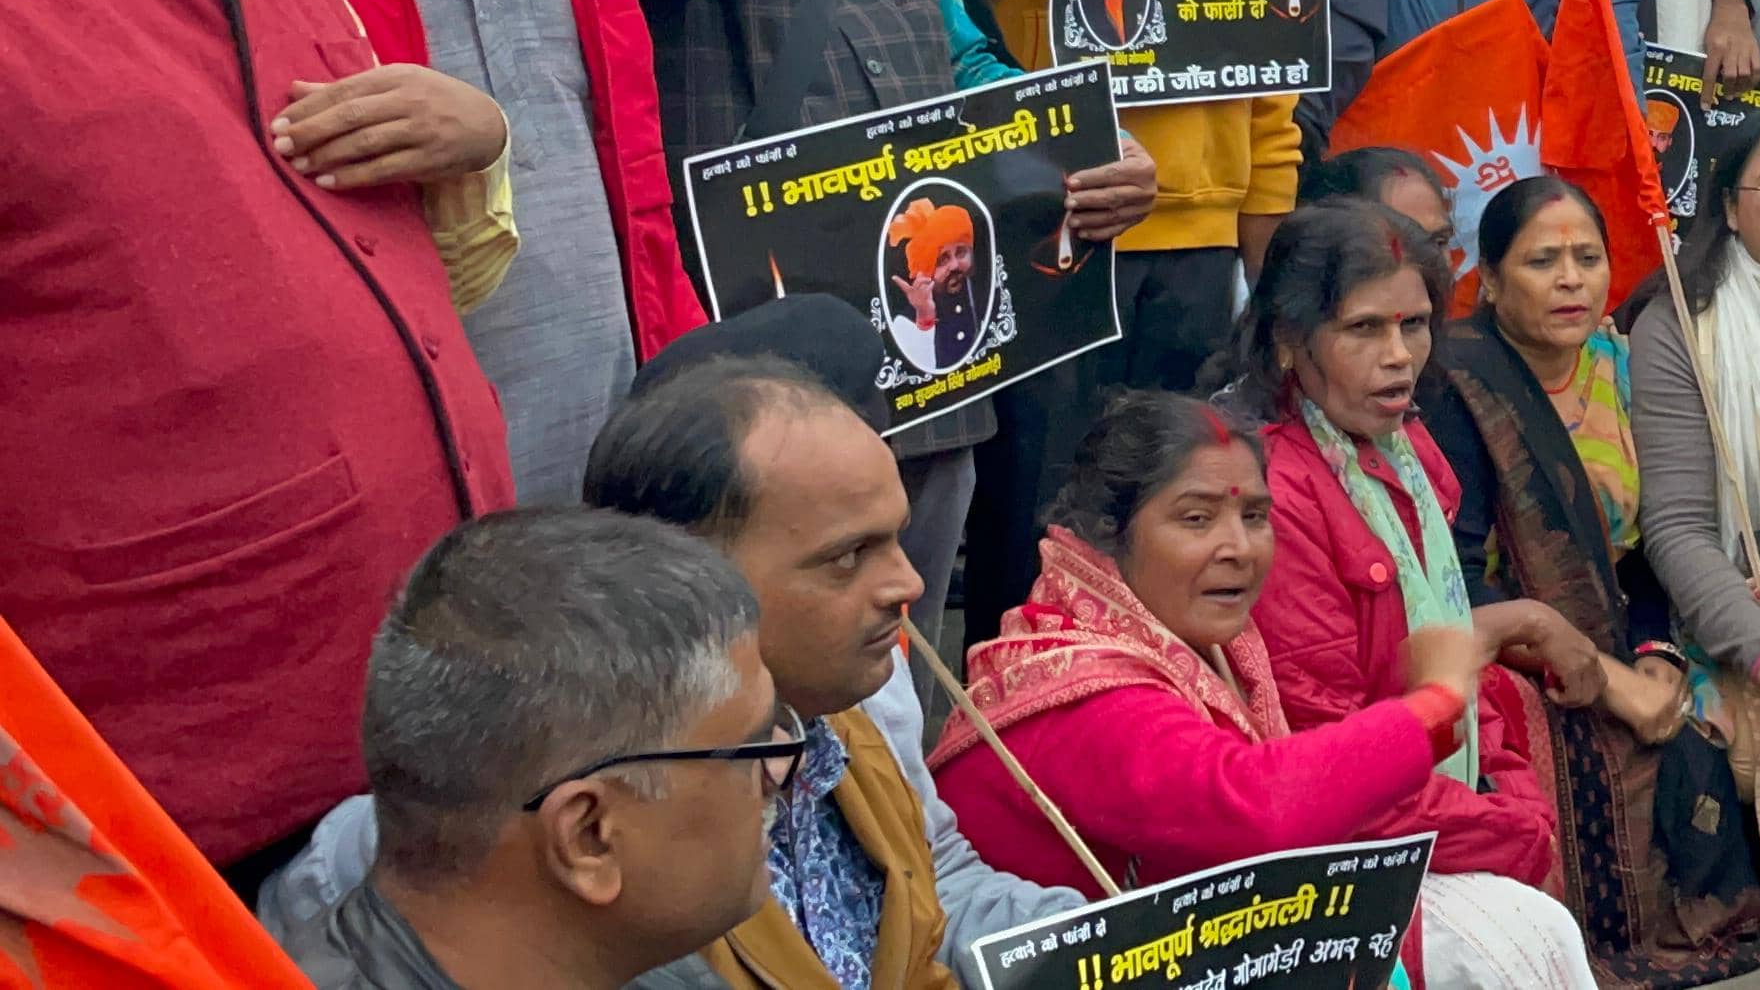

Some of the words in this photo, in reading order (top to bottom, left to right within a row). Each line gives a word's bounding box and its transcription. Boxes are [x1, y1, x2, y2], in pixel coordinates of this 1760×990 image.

[1133, 66, 1165, 94] की
[1221, 65, 1256, 86] CBI
[1260, 60, 1281, 85] से
[1285, 58, 1310, 84] हो
[782, 143, 897, 205] भावपूर्ण
[903, 109, 1038, 174] श्रद्धांजली
[1041, 933, 1058, 951] को
[1095, 917, 1107, 937] दो
[1110, 913, 1196, 984] भावपूर्ण
[1199, 883, 1319, 949] श्रद्धांजली
[1309, 935, 1361, 964] अमर
